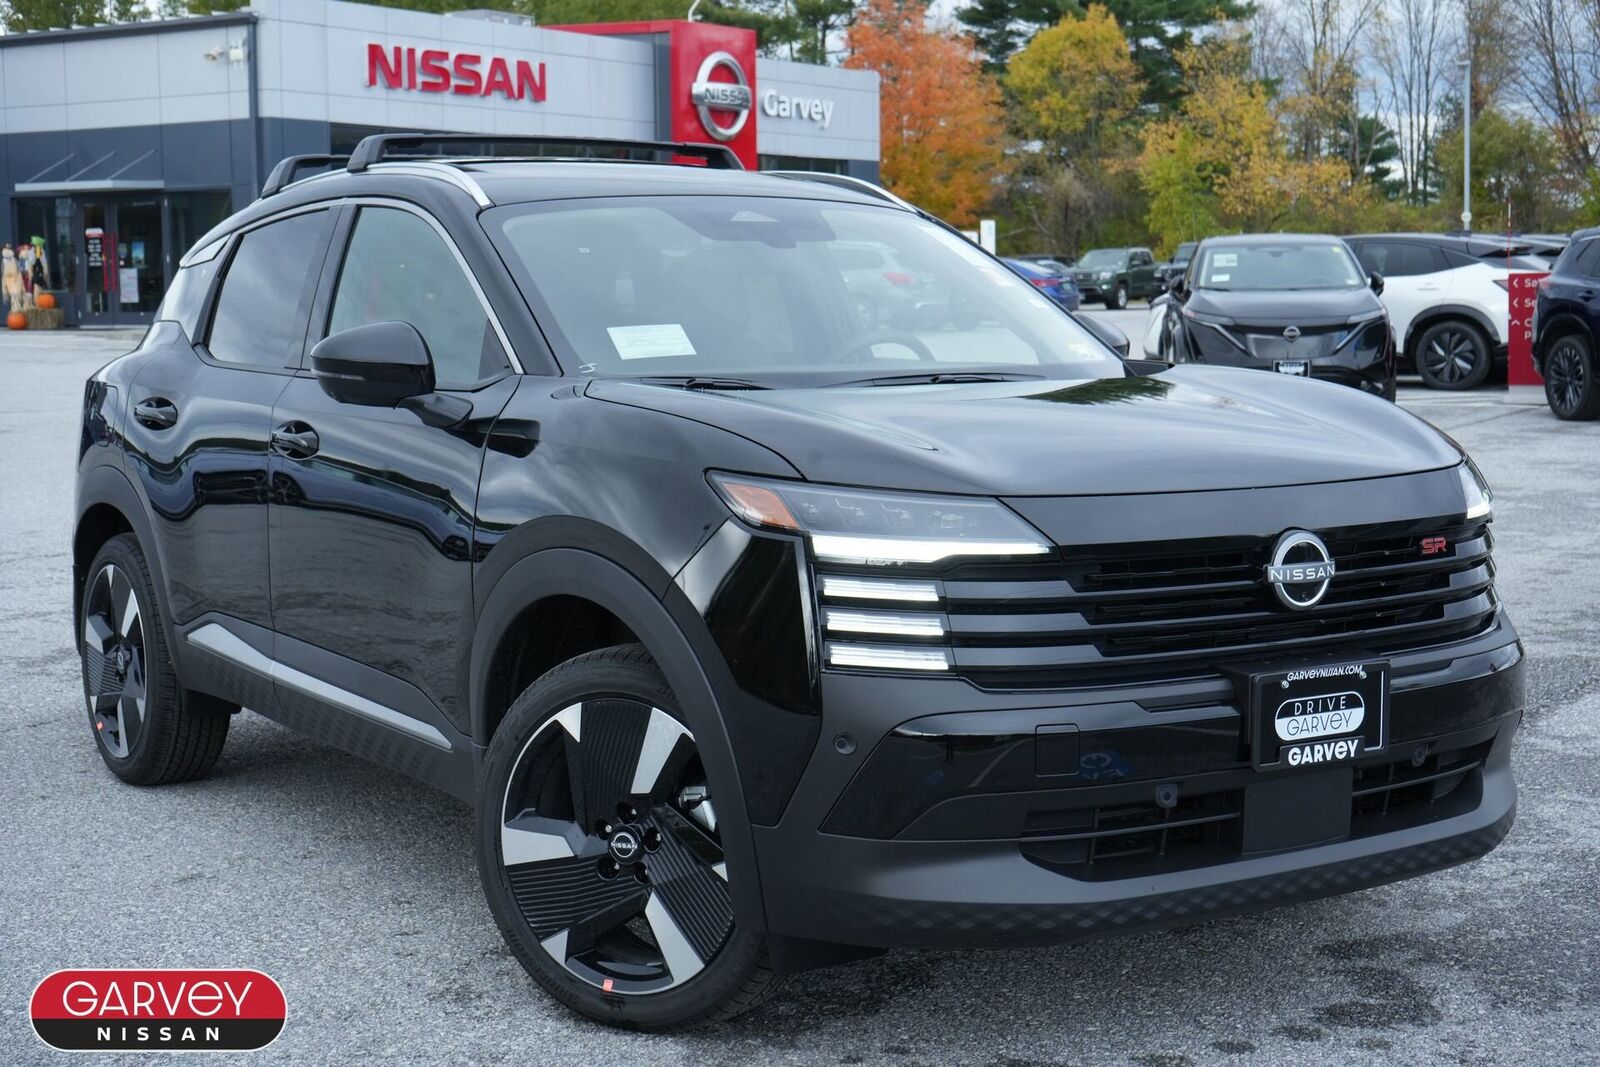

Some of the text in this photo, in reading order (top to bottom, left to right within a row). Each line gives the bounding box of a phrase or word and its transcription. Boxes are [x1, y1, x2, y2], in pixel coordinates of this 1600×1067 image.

[367, 43, 547, 102] NISSAN
[763, 88, 834, 129] Garvey
[1420, 536, 1447, 556] SR
[1269, 564, 1335, 582] NISSAN
[1294, 695, 1347, 715] DRIVE
[1286, 711, 1353, 736] GARVEY
[1287, 739, 1359, 766] GARVEY
